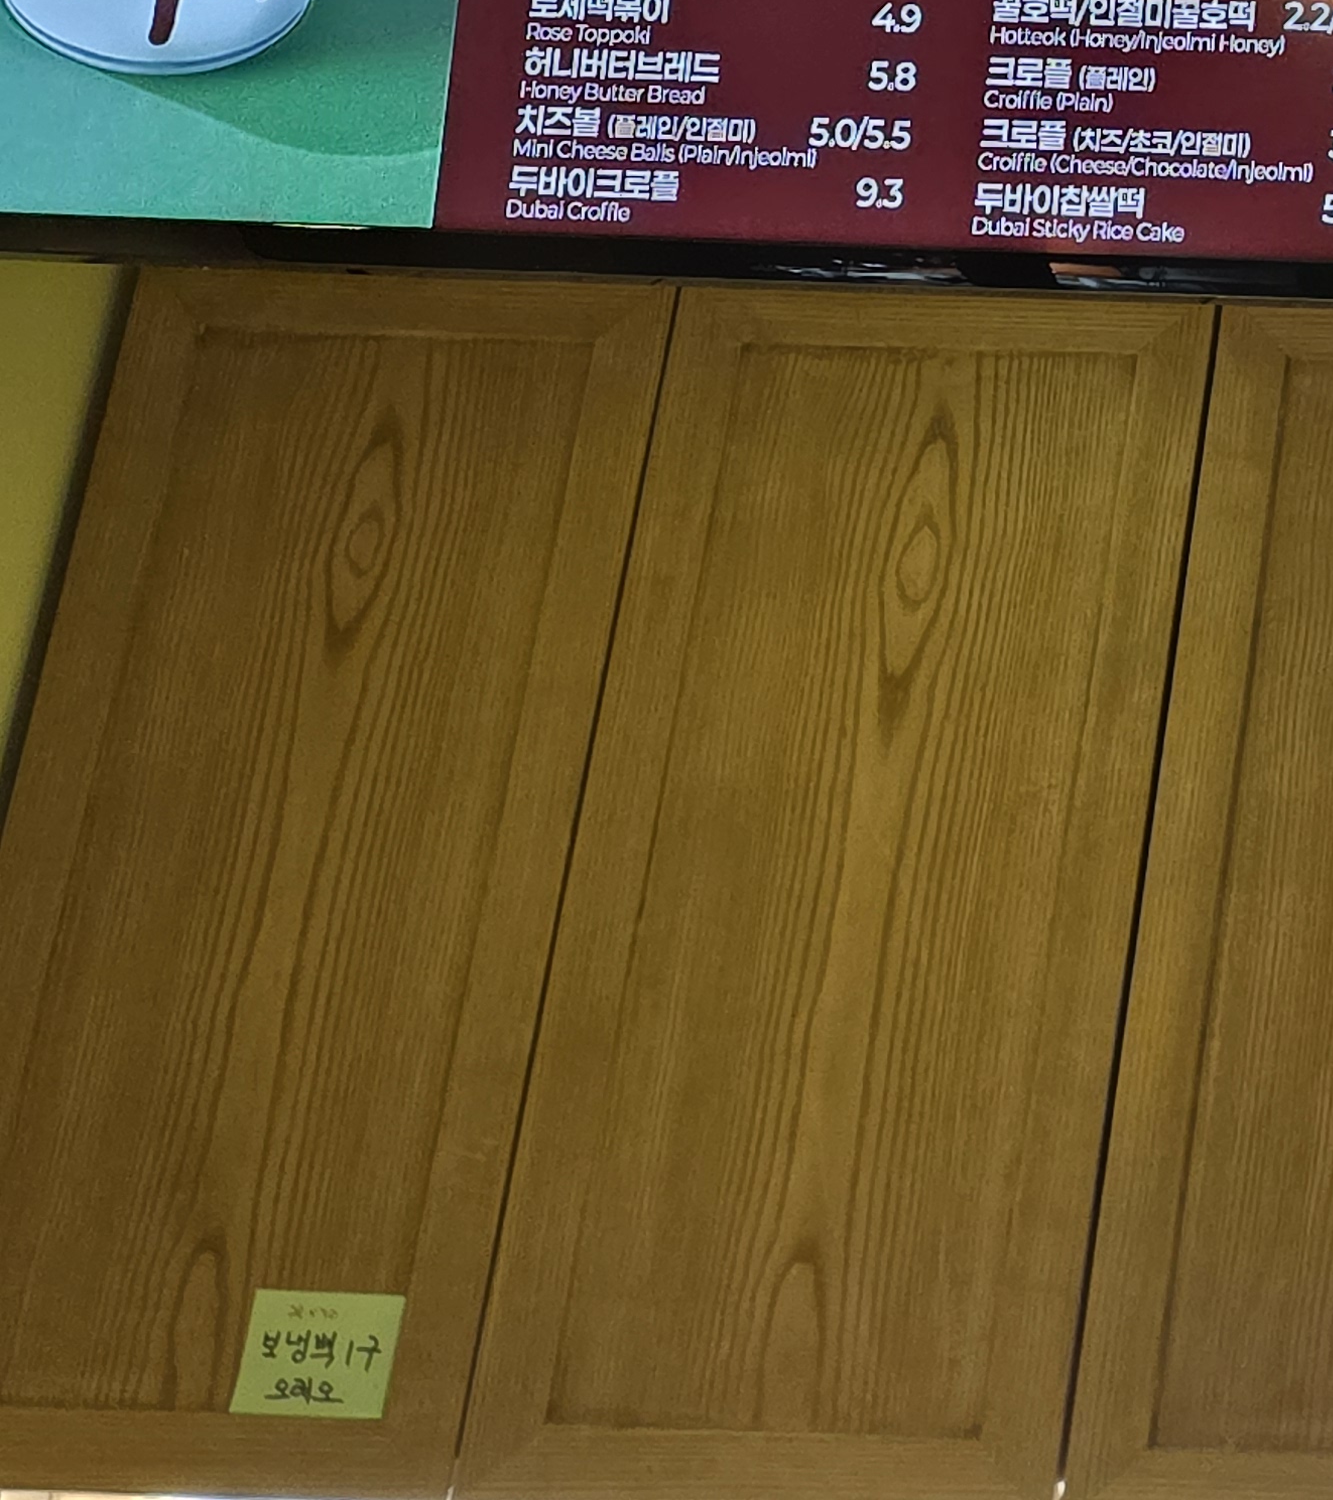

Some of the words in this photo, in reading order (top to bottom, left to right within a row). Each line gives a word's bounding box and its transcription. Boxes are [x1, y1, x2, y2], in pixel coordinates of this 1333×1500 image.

[524, 45, 721, 84] 허니버터브레드
[519, 79, 583, 105] Honey
[583, 81, 645, 103] Butter
[646, 84, 706, 105] Bread
[508, 164, 679, 202] 두바이크로플
[973, 181, 1145, 219] 두바이찹쌀떡
